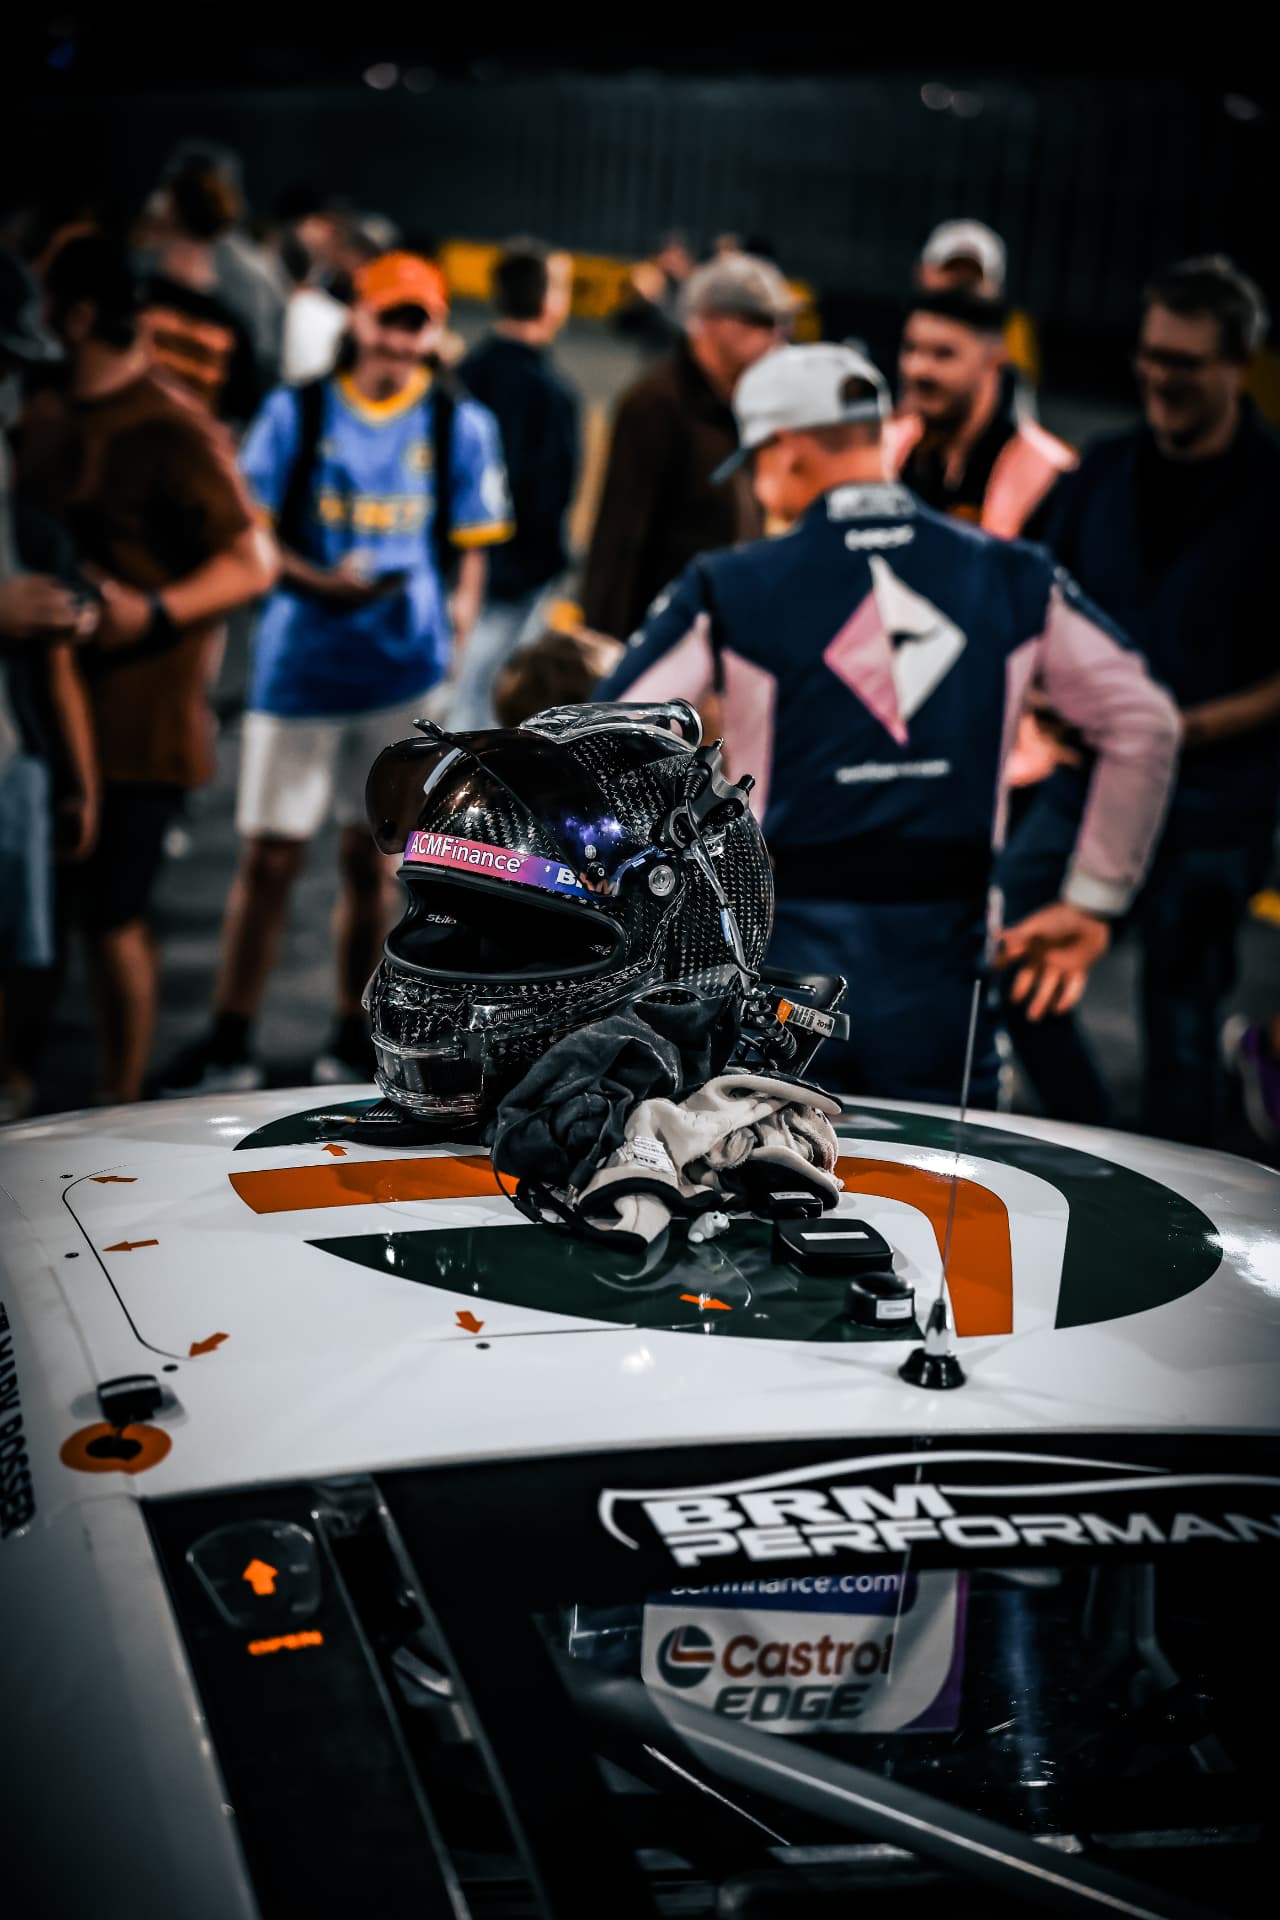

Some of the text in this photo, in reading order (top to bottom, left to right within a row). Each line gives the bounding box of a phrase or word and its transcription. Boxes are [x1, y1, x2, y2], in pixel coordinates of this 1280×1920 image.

[411, 833, 521, 873] ACMFinance
[641, 1484, 956, 1537] BRM
[722, 1633, 894, 1679] Castrol
[713, 1683, 872, 1722] EDGE
